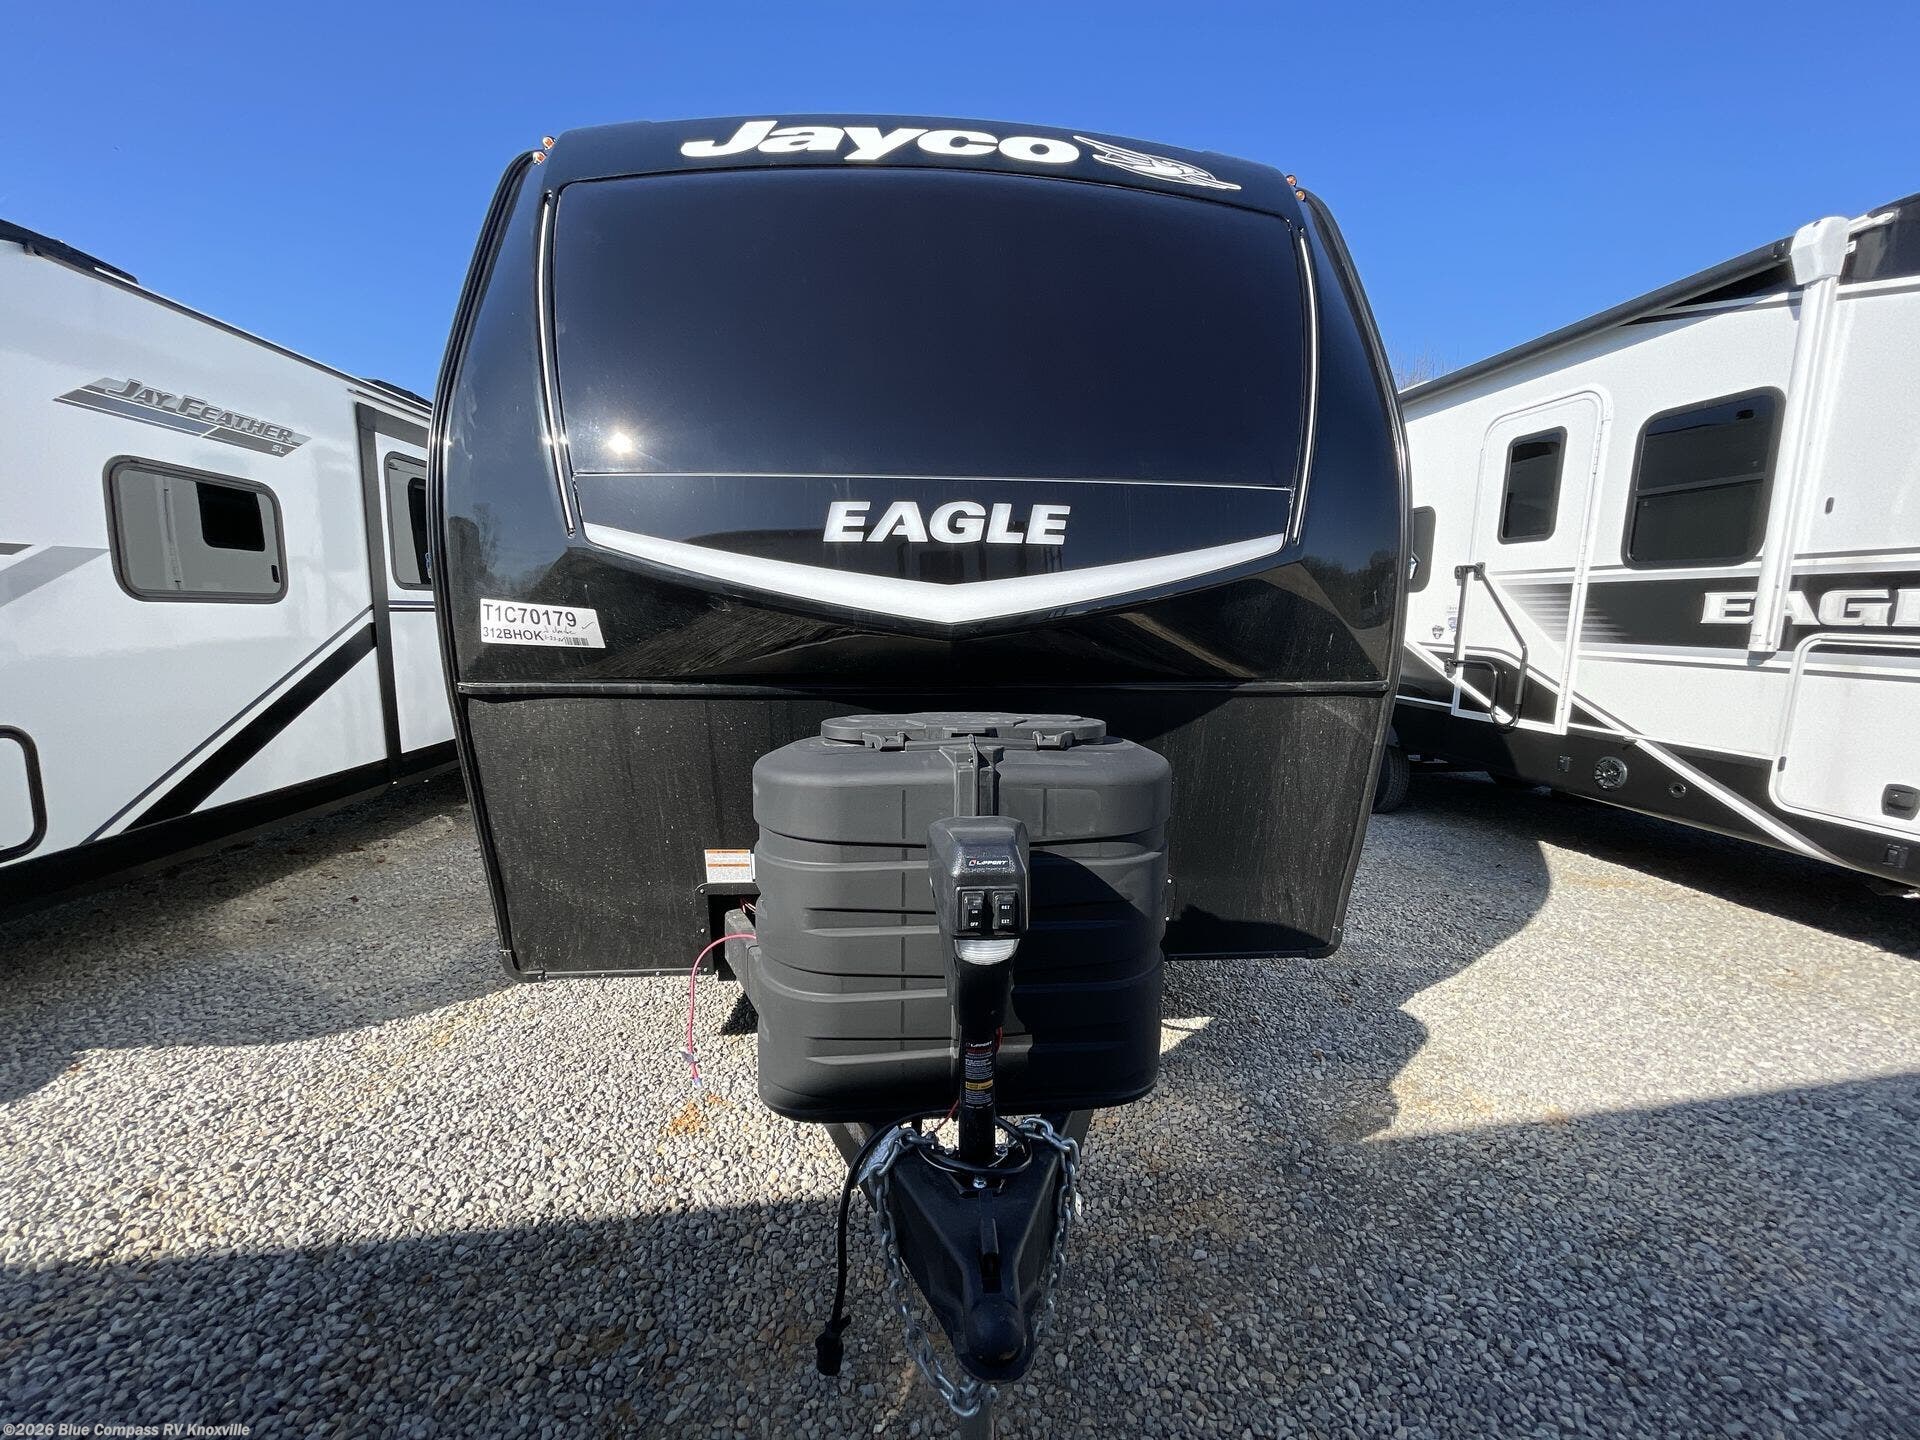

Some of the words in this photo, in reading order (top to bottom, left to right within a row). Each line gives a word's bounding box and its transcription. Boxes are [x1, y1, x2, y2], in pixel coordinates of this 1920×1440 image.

[681, 120, 1080, 163] Jayco
[176, 395, 296, 444] FEATHER
[271, 444, 285, 455] SL
[822, 501, 1071, 545] EAGLE
[483, 604, 577, 628] T1C70179
[483, 627, 545, 642] 312BHOK
